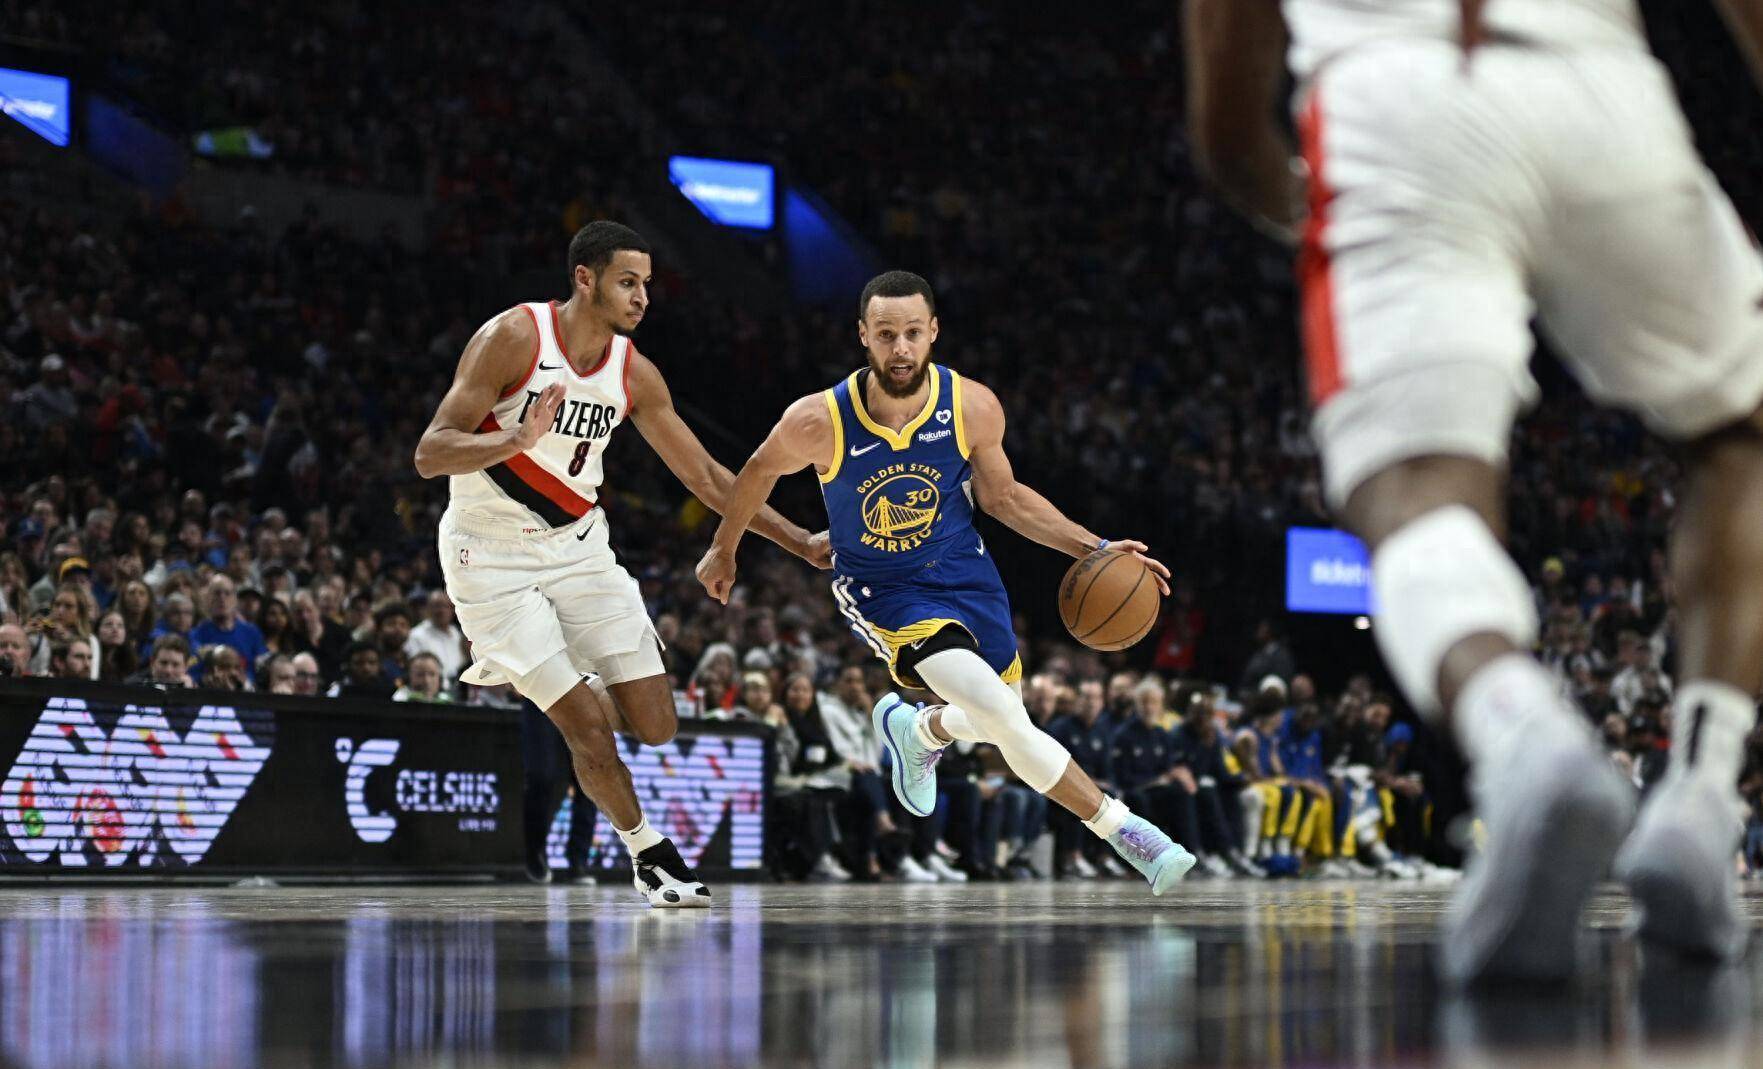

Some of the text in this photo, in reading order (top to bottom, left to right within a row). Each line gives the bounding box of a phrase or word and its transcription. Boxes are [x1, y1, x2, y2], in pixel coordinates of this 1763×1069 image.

[918, 429, 951, 442] Rakuten
[567, 440, 592, 478] 8
[857, 463, 942, 494] GOLDEN STATE
[905, 488, 933, 507] 30
[396, 769, 498, 813] CELSIUS
